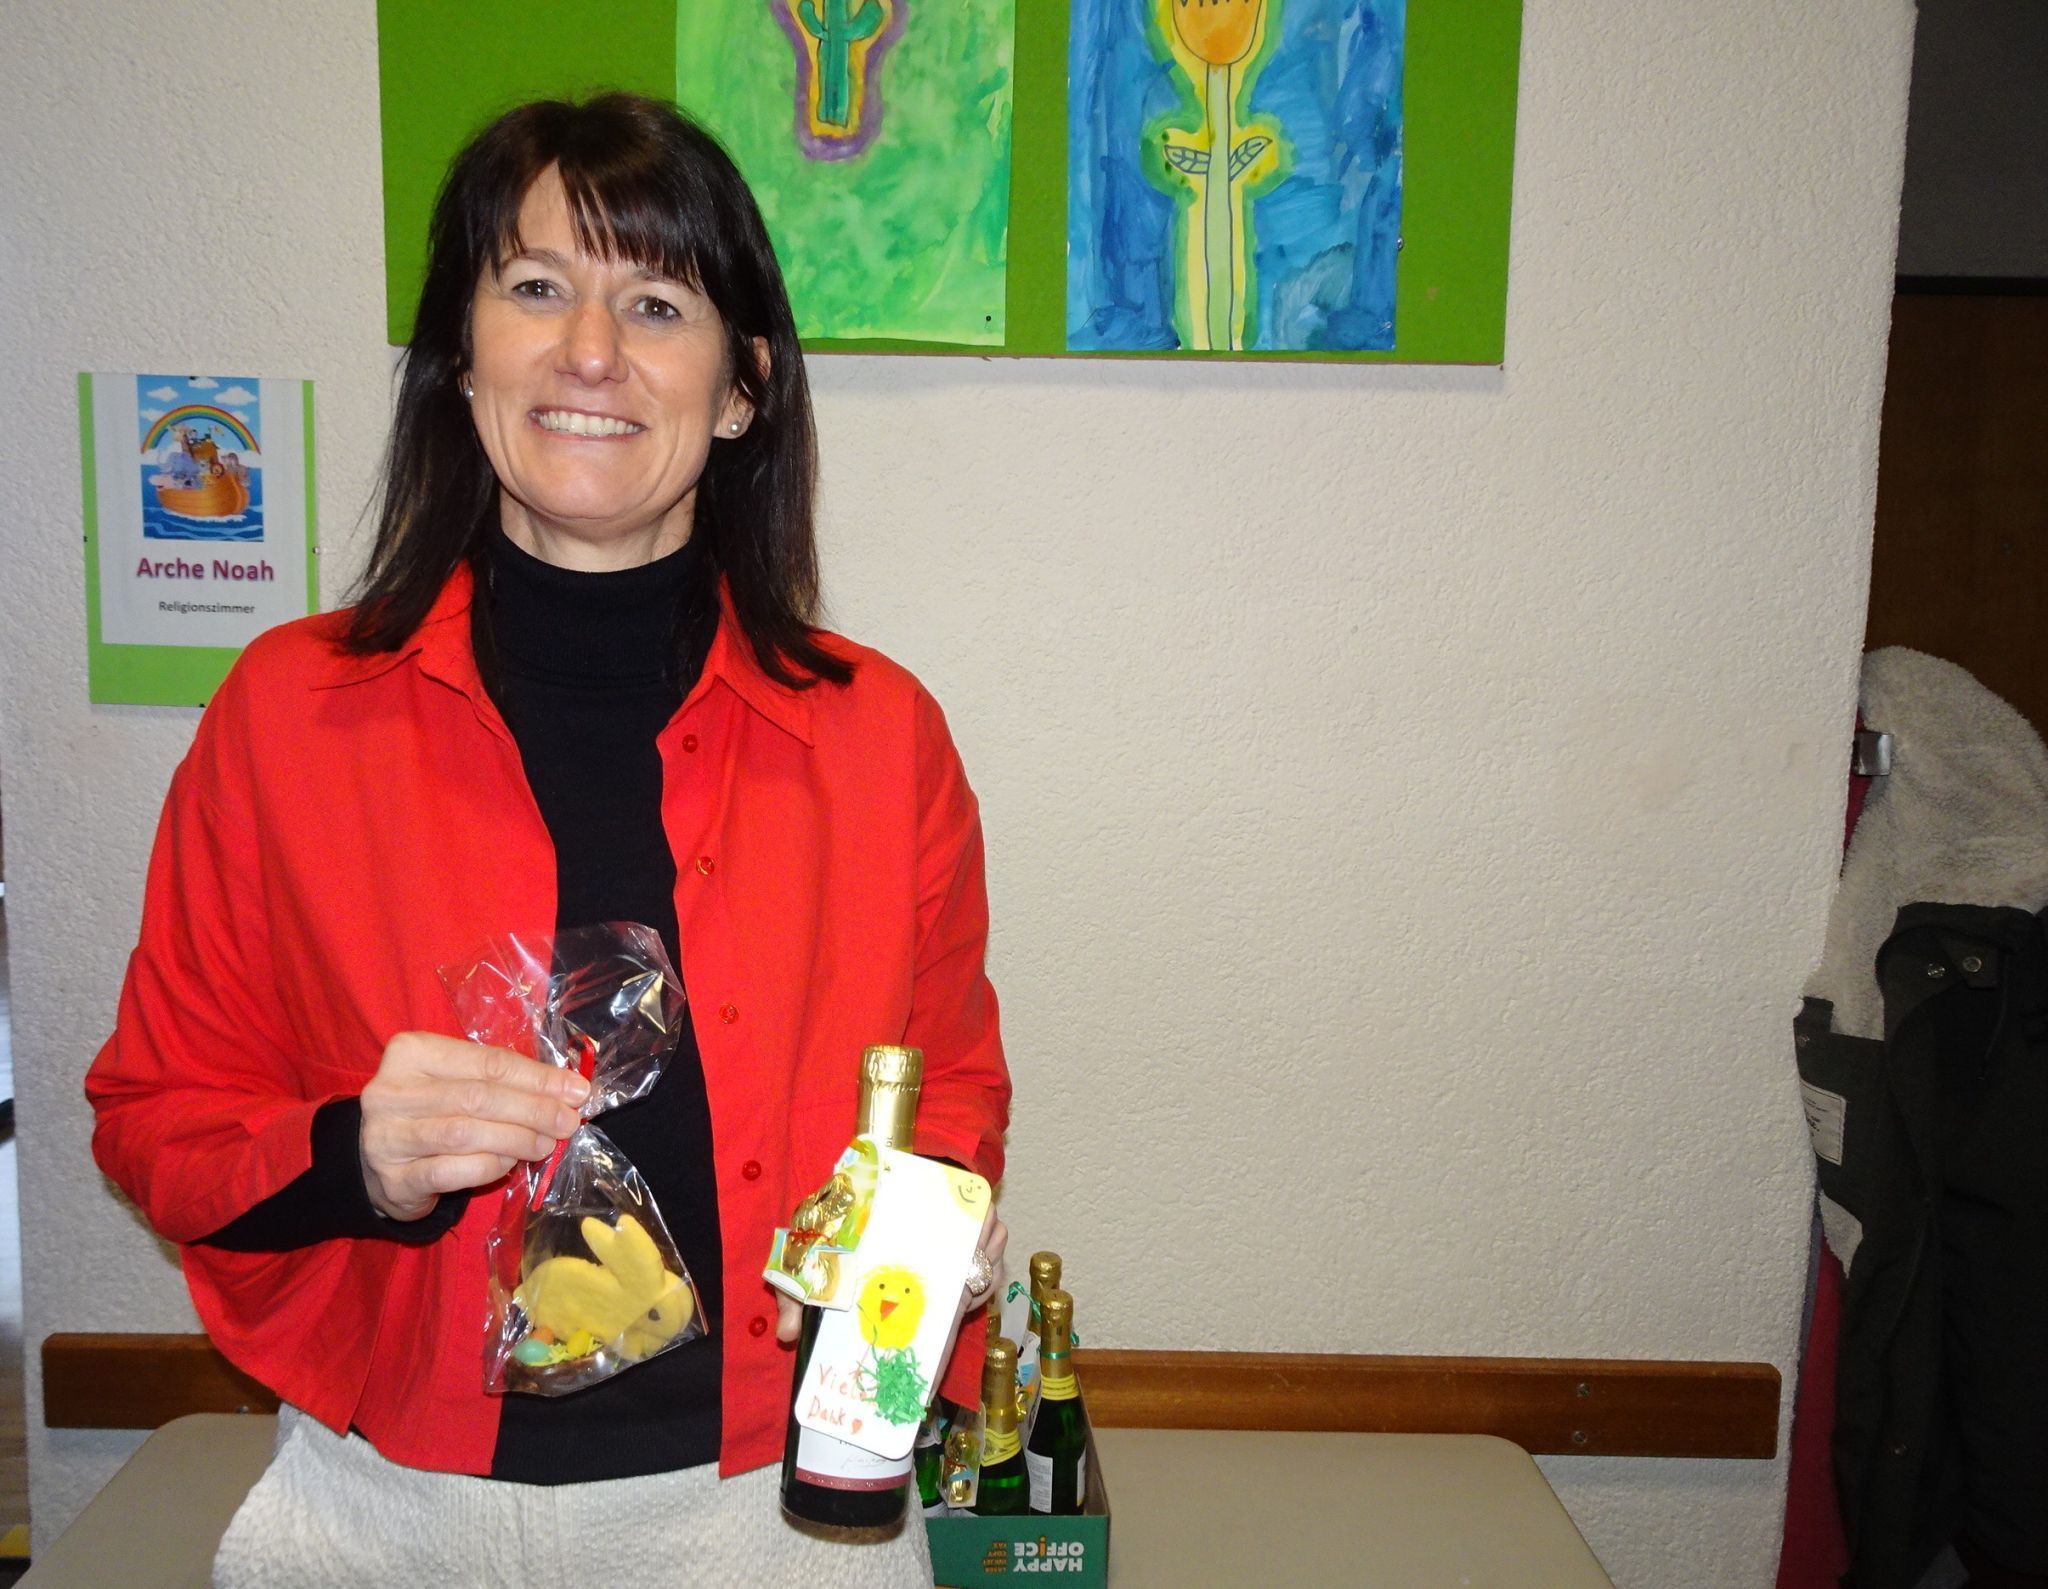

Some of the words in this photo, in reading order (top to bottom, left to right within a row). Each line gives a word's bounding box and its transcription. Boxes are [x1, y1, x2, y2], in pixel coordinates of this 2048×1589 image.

[136, 556, 204, 579] Arche
[213, 558, 274, 581] Noah
[158, 600, 256, 615] Religionszimmer
[807, 1394, 847, 1426] Dank
[1013, 1557, 1083, 1573] HAPPY
